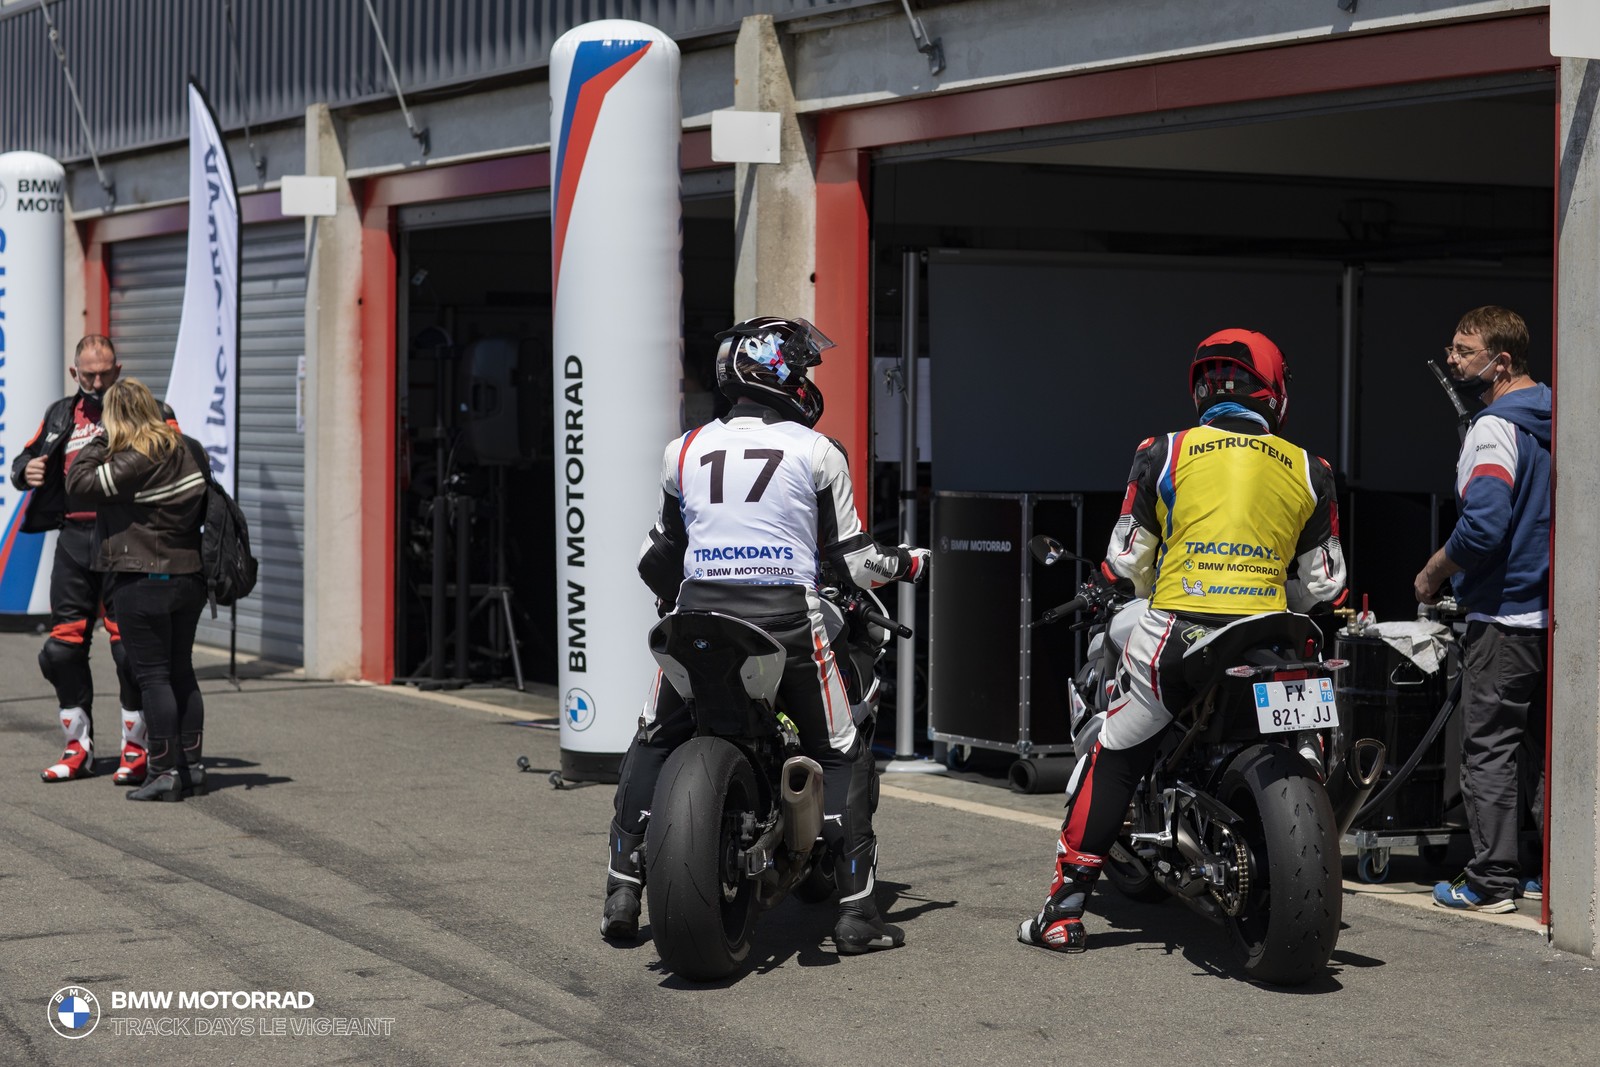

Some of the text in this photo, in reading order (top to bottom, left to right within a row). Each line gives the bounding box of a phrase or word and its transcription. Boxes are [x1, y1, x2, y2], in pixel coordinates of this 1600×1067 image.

[18, 179, 61, 193] BMW
[564, 354, 585, 567] MOTORRAD
[1188, 437, 1293, 470] INSTRUCTEUR
[700, 448, 784, 504] 17
[950, 540, 1012, 552] BMW MOTORRAD
[693, 546, 794, 563] TRACKDAYS
[706, 566, 794, 577] BMW MOTORRAD
[864, 558, 882, 574] BMW
[1198, 562, 1280, 577] BMW MOTORRAD
[1207, 585, 1277, 597] MICHELIN
[567, 579, 587, 673] BMW
[1321, 691, 1333, 701] 78
